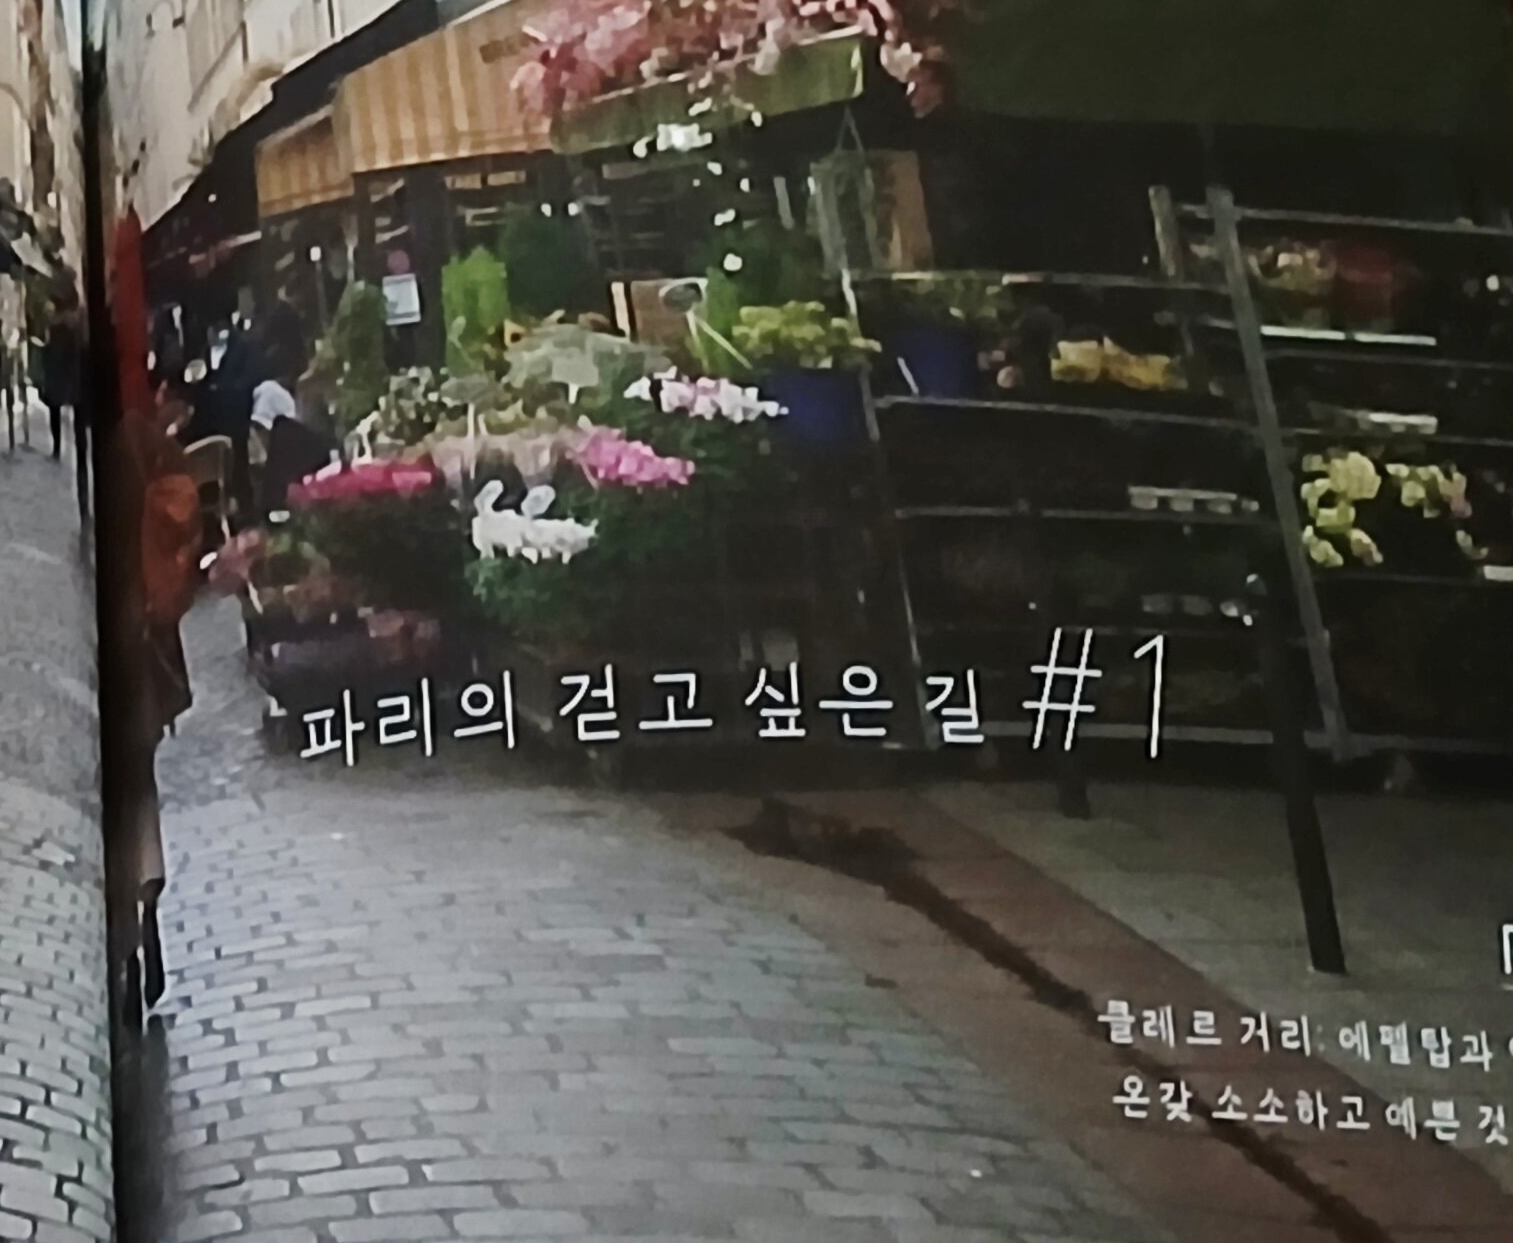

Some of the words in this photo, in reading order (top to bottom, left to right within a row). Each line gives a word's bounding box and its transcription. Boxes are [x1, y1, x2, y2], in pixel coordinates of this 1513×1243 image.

[300, 670, 515, 767] 파리의
[558, 663, 714, 741] 걷고
[745, 661, 894, 738] 싶은
[924, 668, 985, 744] 길
[1112, 1075, 1193, 1123] 온갖
[1211, 1085, 1371, 1132] 소소하고
